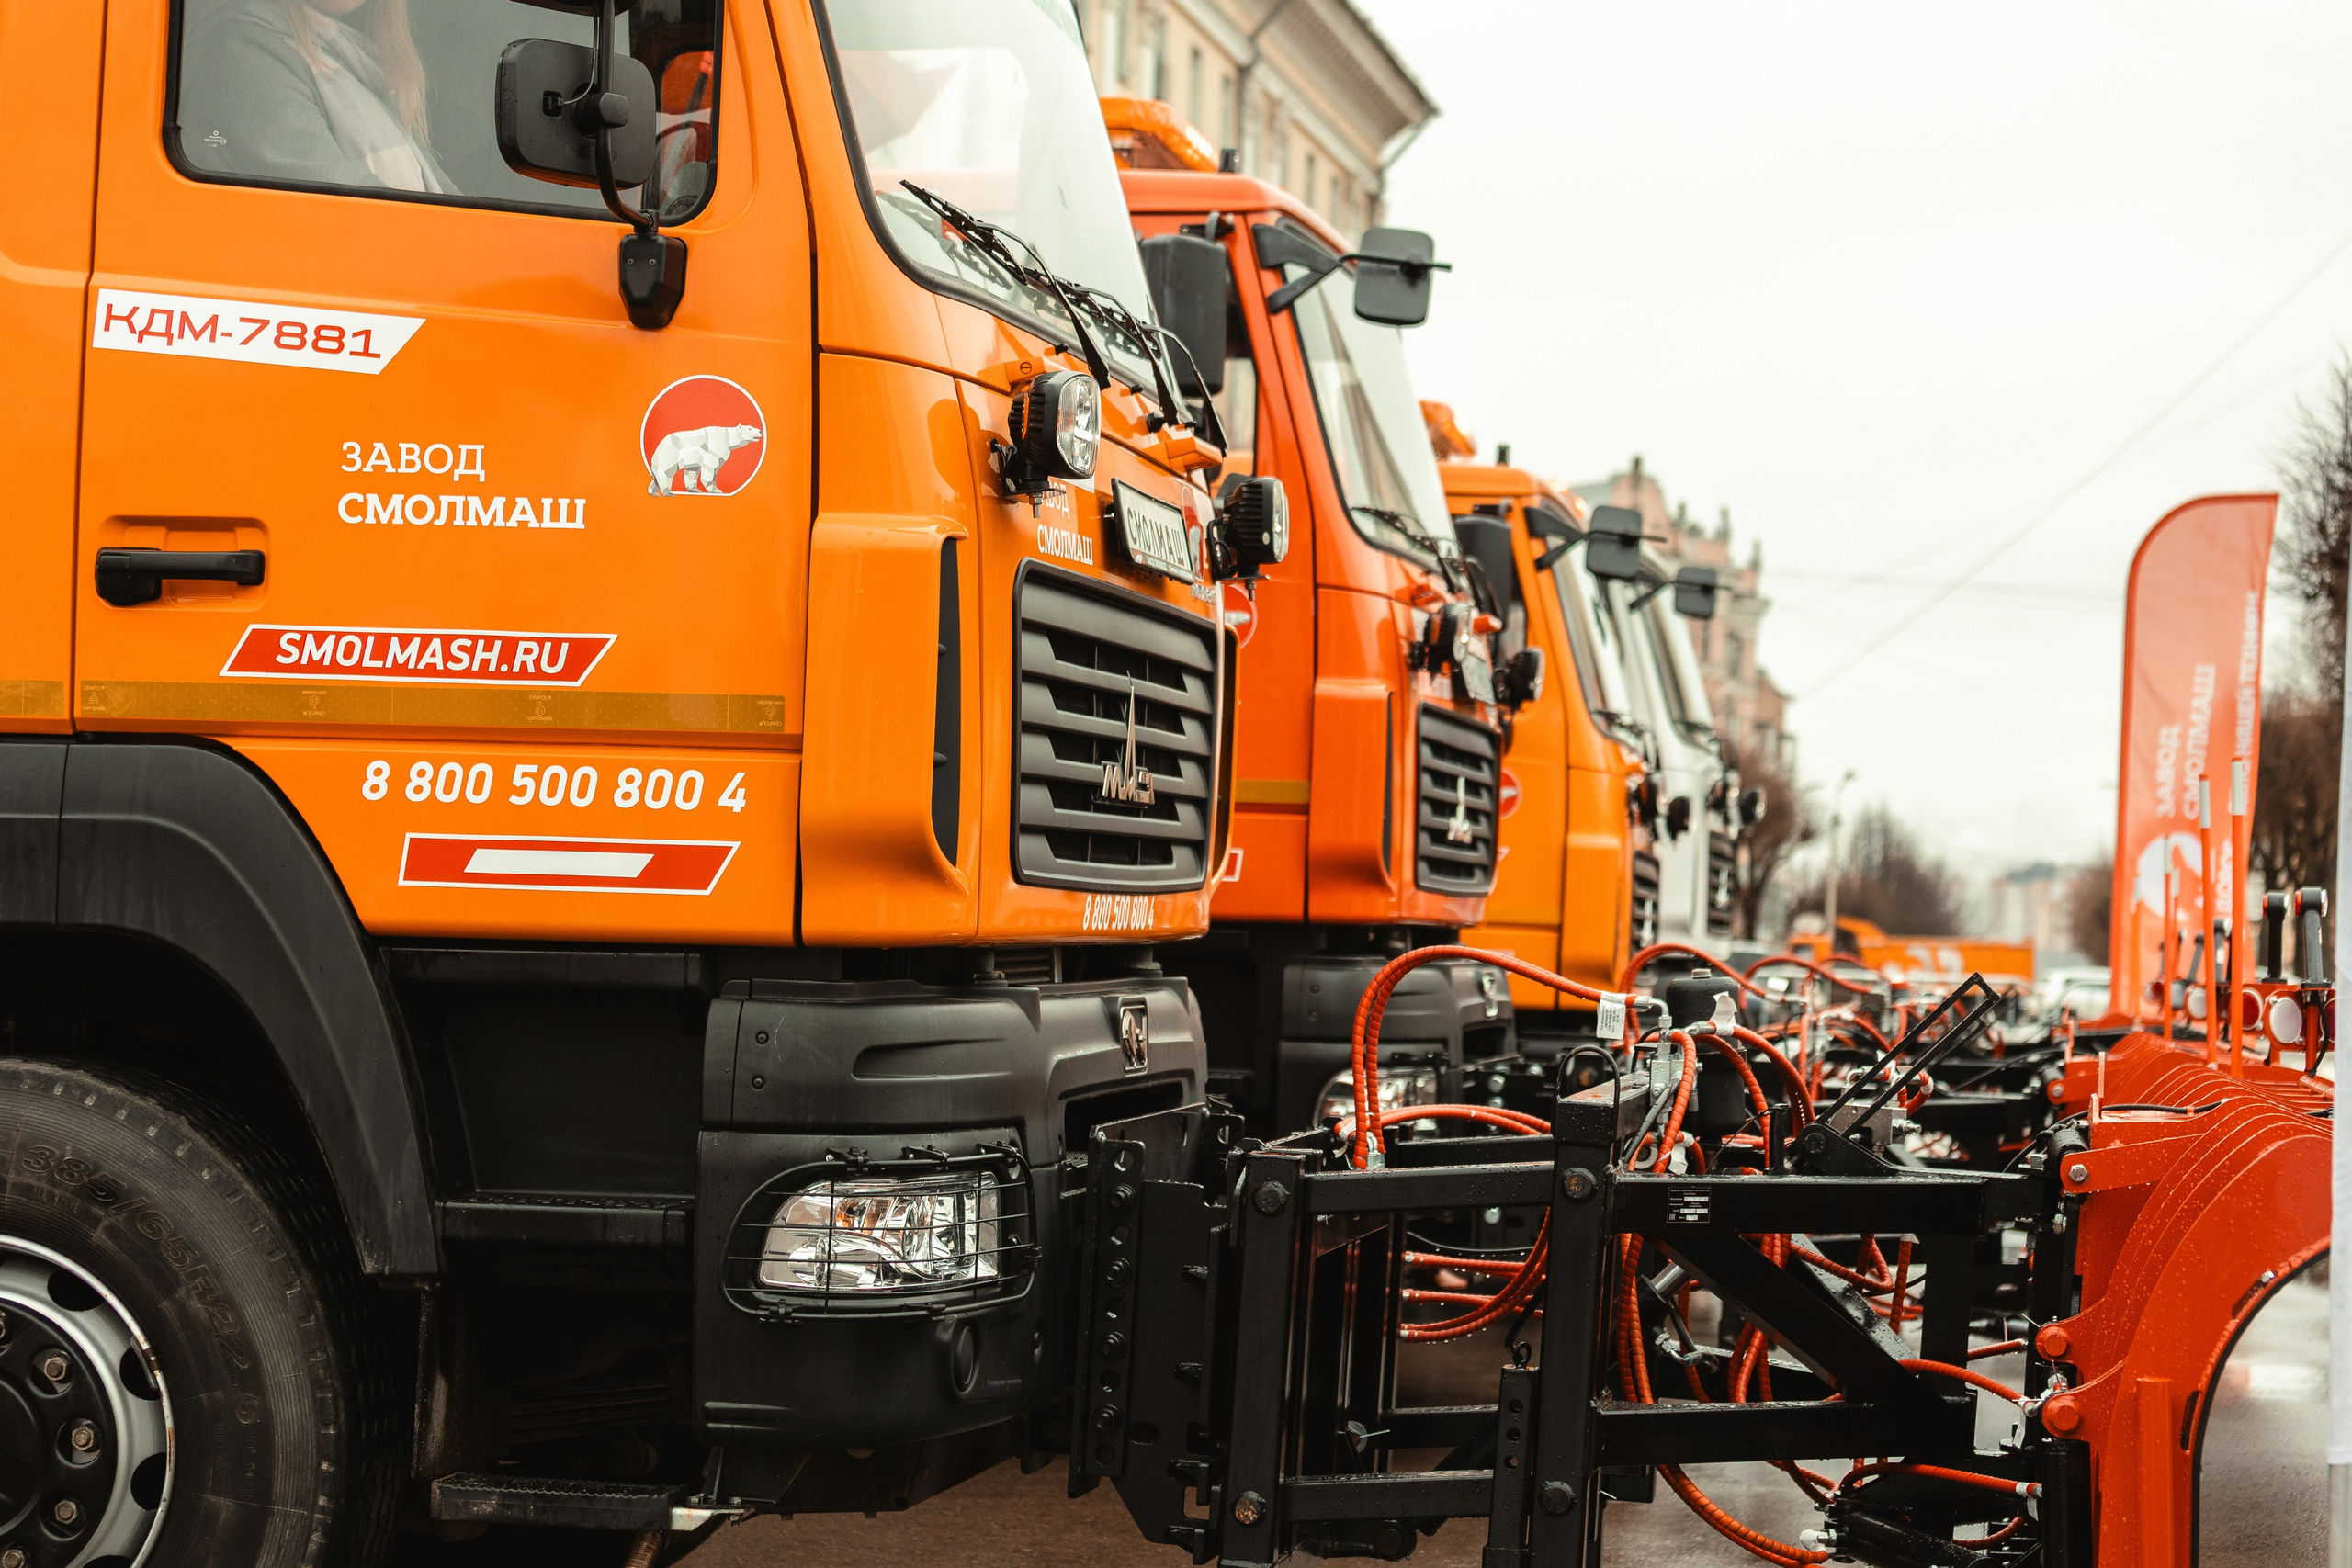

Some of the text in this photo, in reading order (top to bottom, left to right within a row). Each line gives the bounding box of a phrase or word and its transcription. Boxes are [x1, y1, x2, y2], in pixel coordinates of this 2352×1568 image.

[103, 303, 382, 359] КДМ-7881
[340, 441, 486, 483] ЗАВОД
[337, 492, 587, 530] СМОЛМАШ
[1037, 524, 1093, 566] СМОЛМАШ
[1128, 507, 1185, 566] СМОЛМАШ
[275, 632, 570, 674] SMOLMASH.RU
[2182, 662, 2218, 821] СМОЛМАШ
[361, 760, 747, 813] 8 800 500 800 4
[2154, 723, 2183, 819] ЗАВОД
[1082, 894, 1156, 931] 8 800 500 800 4
